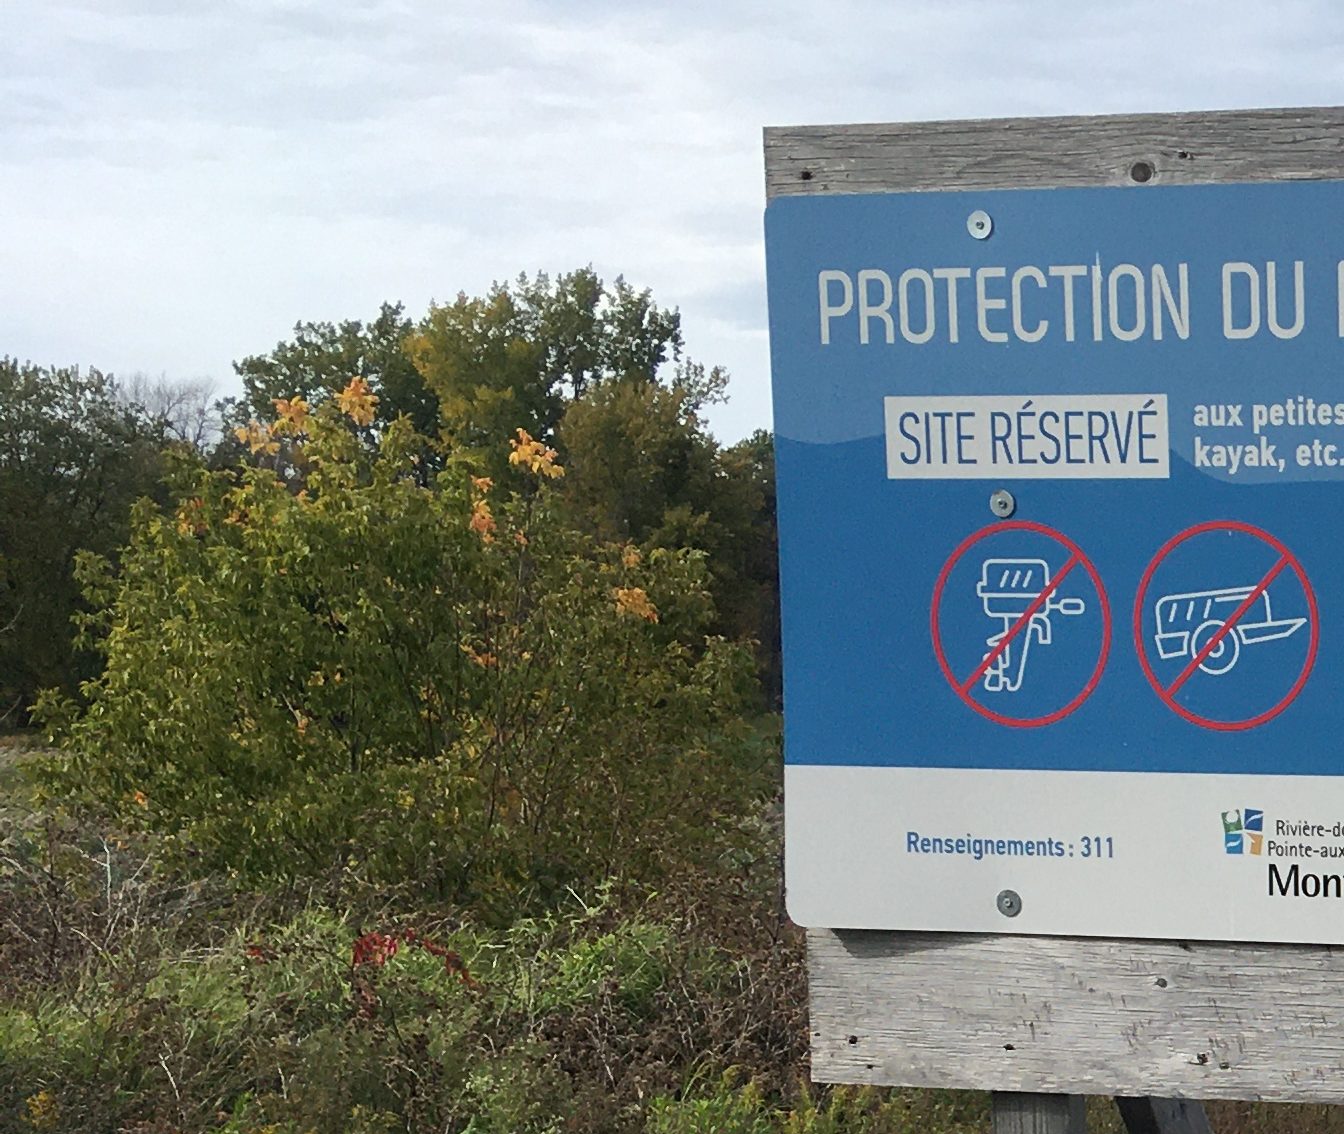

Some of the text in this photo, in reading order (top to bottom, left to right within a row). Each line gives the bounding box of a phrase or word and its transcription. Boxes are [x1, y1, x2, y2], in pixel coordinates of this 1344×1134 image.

[817, 263, 1190, 346] PROTECTION
[1221, 260, 1305, 340] DU
[898, 399, 1158, 465] SITE RÉSERVÉ
[1193, 403, 1244, 427] aux
[1194, 436, 1286, 475] kayak,
[1080, 835, 1113, 858] 311
